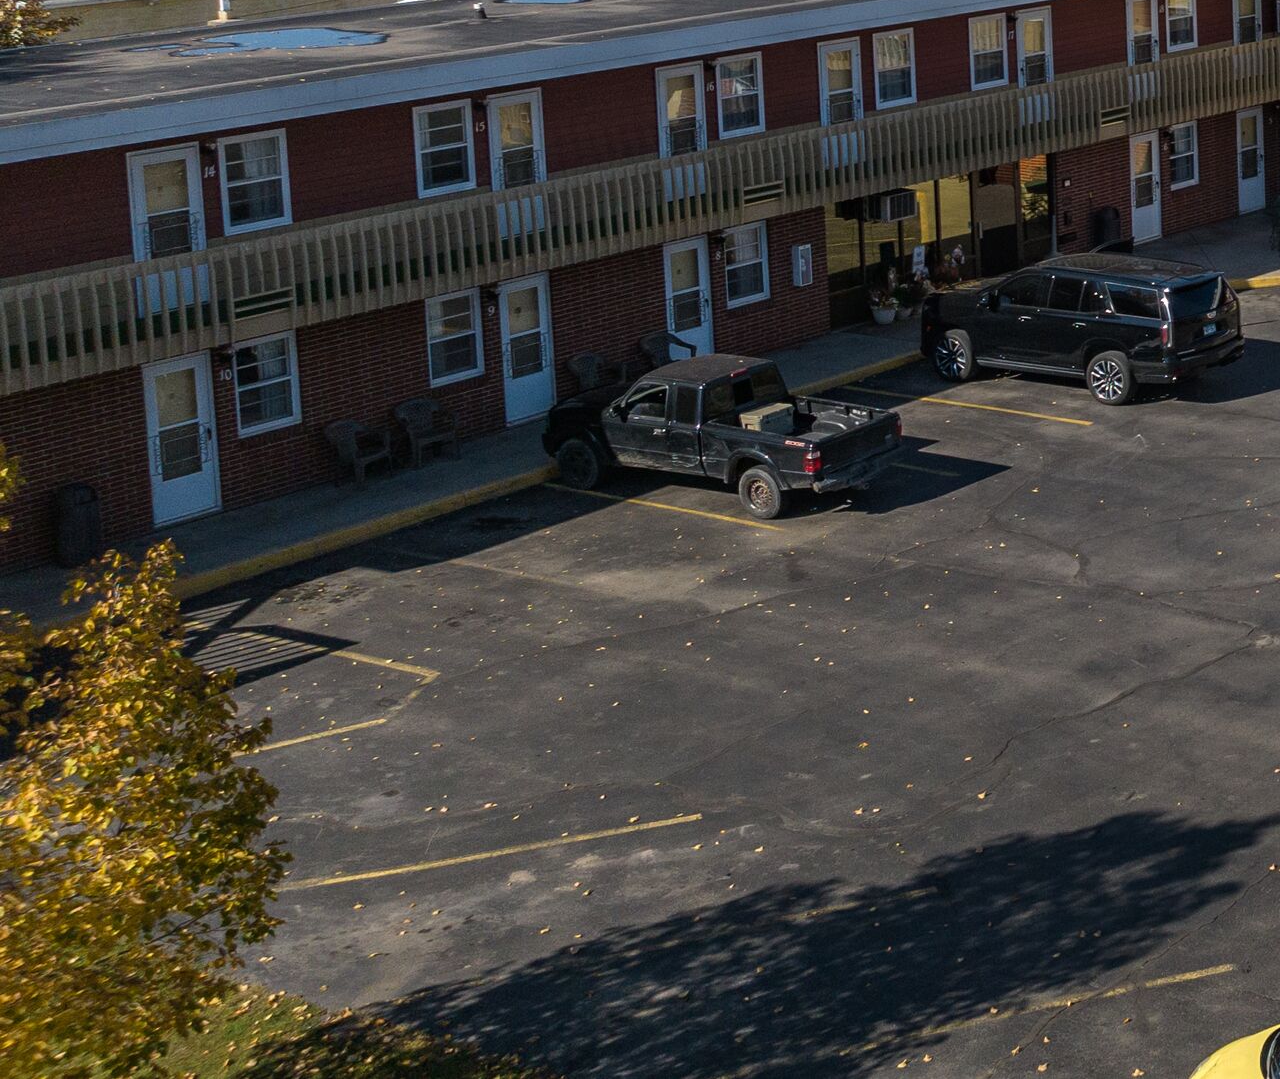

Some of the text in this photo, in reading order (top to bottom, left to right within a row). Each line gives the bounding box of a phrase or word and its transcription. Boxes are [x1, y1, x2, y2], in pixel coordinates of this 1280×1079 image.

[475, 121, 486, 133] 15
[203, 164, 217, 179] 14
[487, 305, 496, 317] 9
[219, 369, 232, 381] 10
